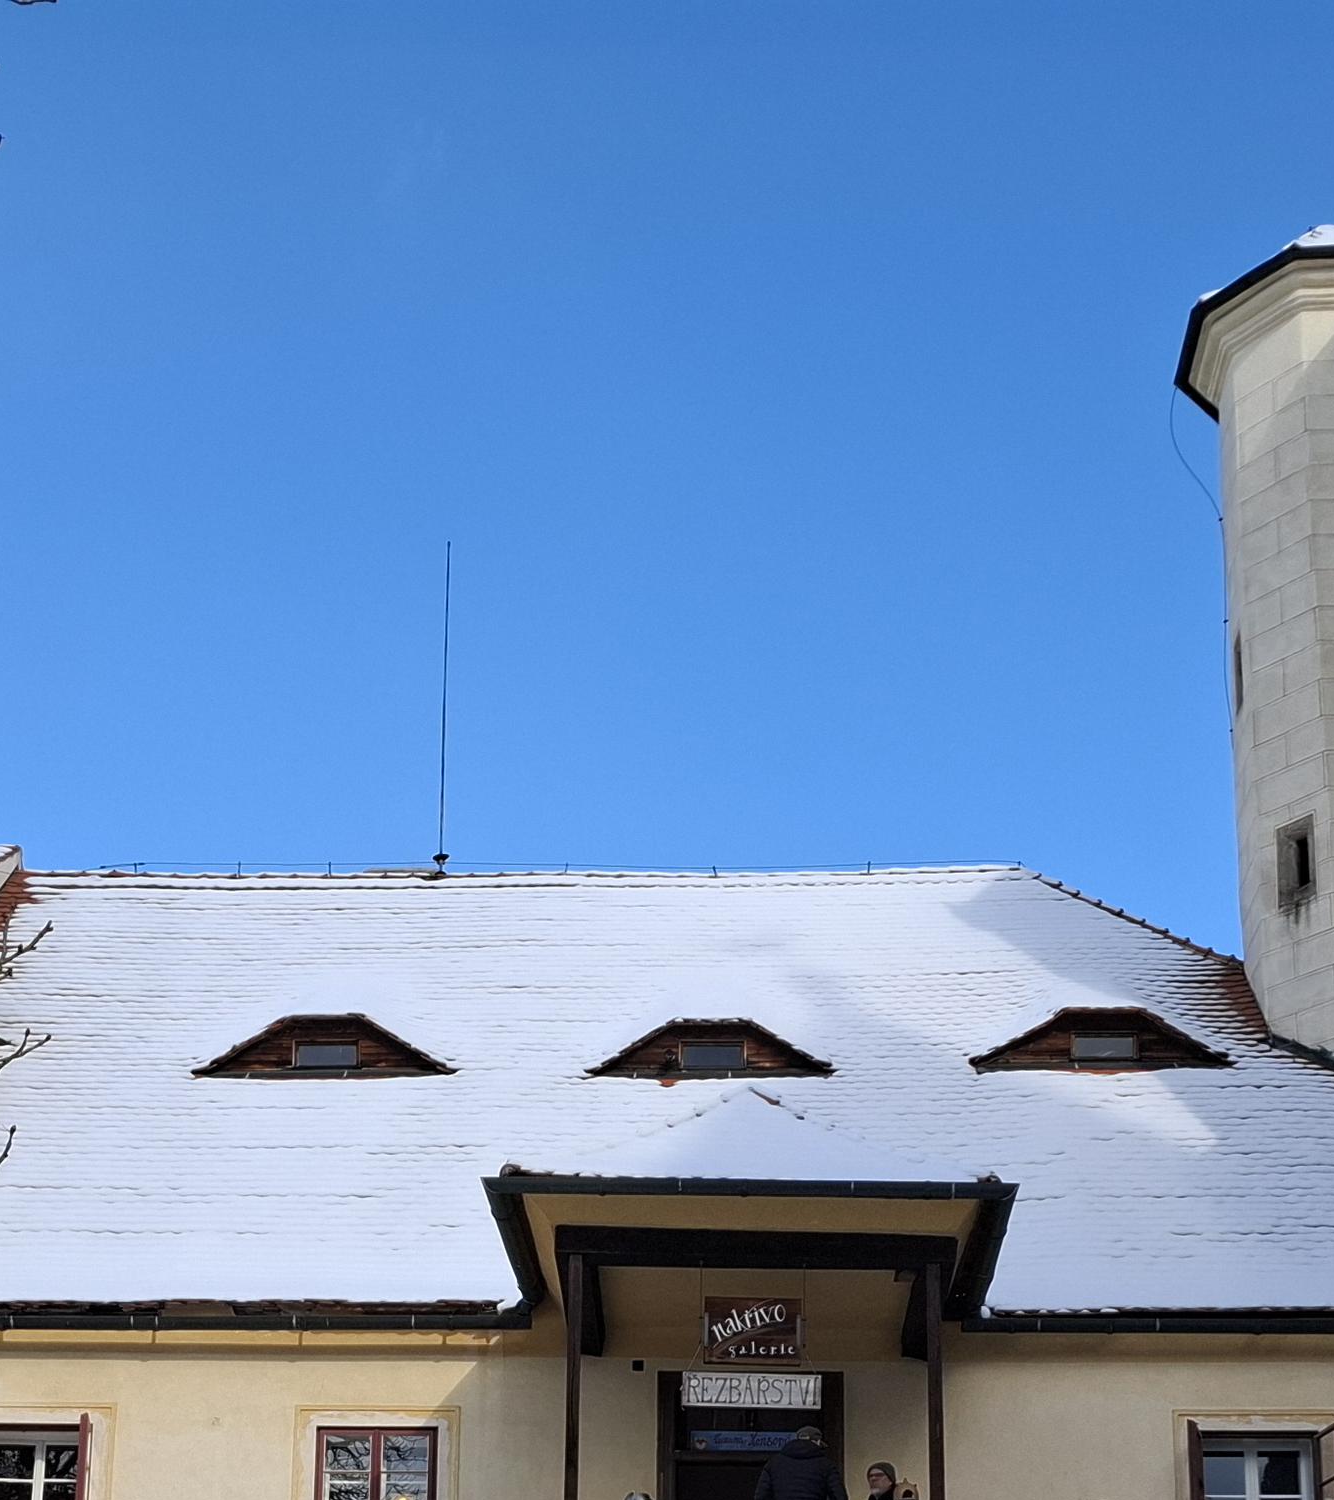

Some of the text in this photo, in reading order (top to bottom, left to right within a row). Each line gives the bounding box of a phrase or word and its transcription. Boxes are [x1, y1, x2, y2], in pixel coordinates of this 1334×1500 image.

[711, 1300, 787, 1342] nakřivo
[728, 1341, 796, 1358] galerie
[686, 1374, 821, 1406] ŘEZBÁŘSTVÍ
